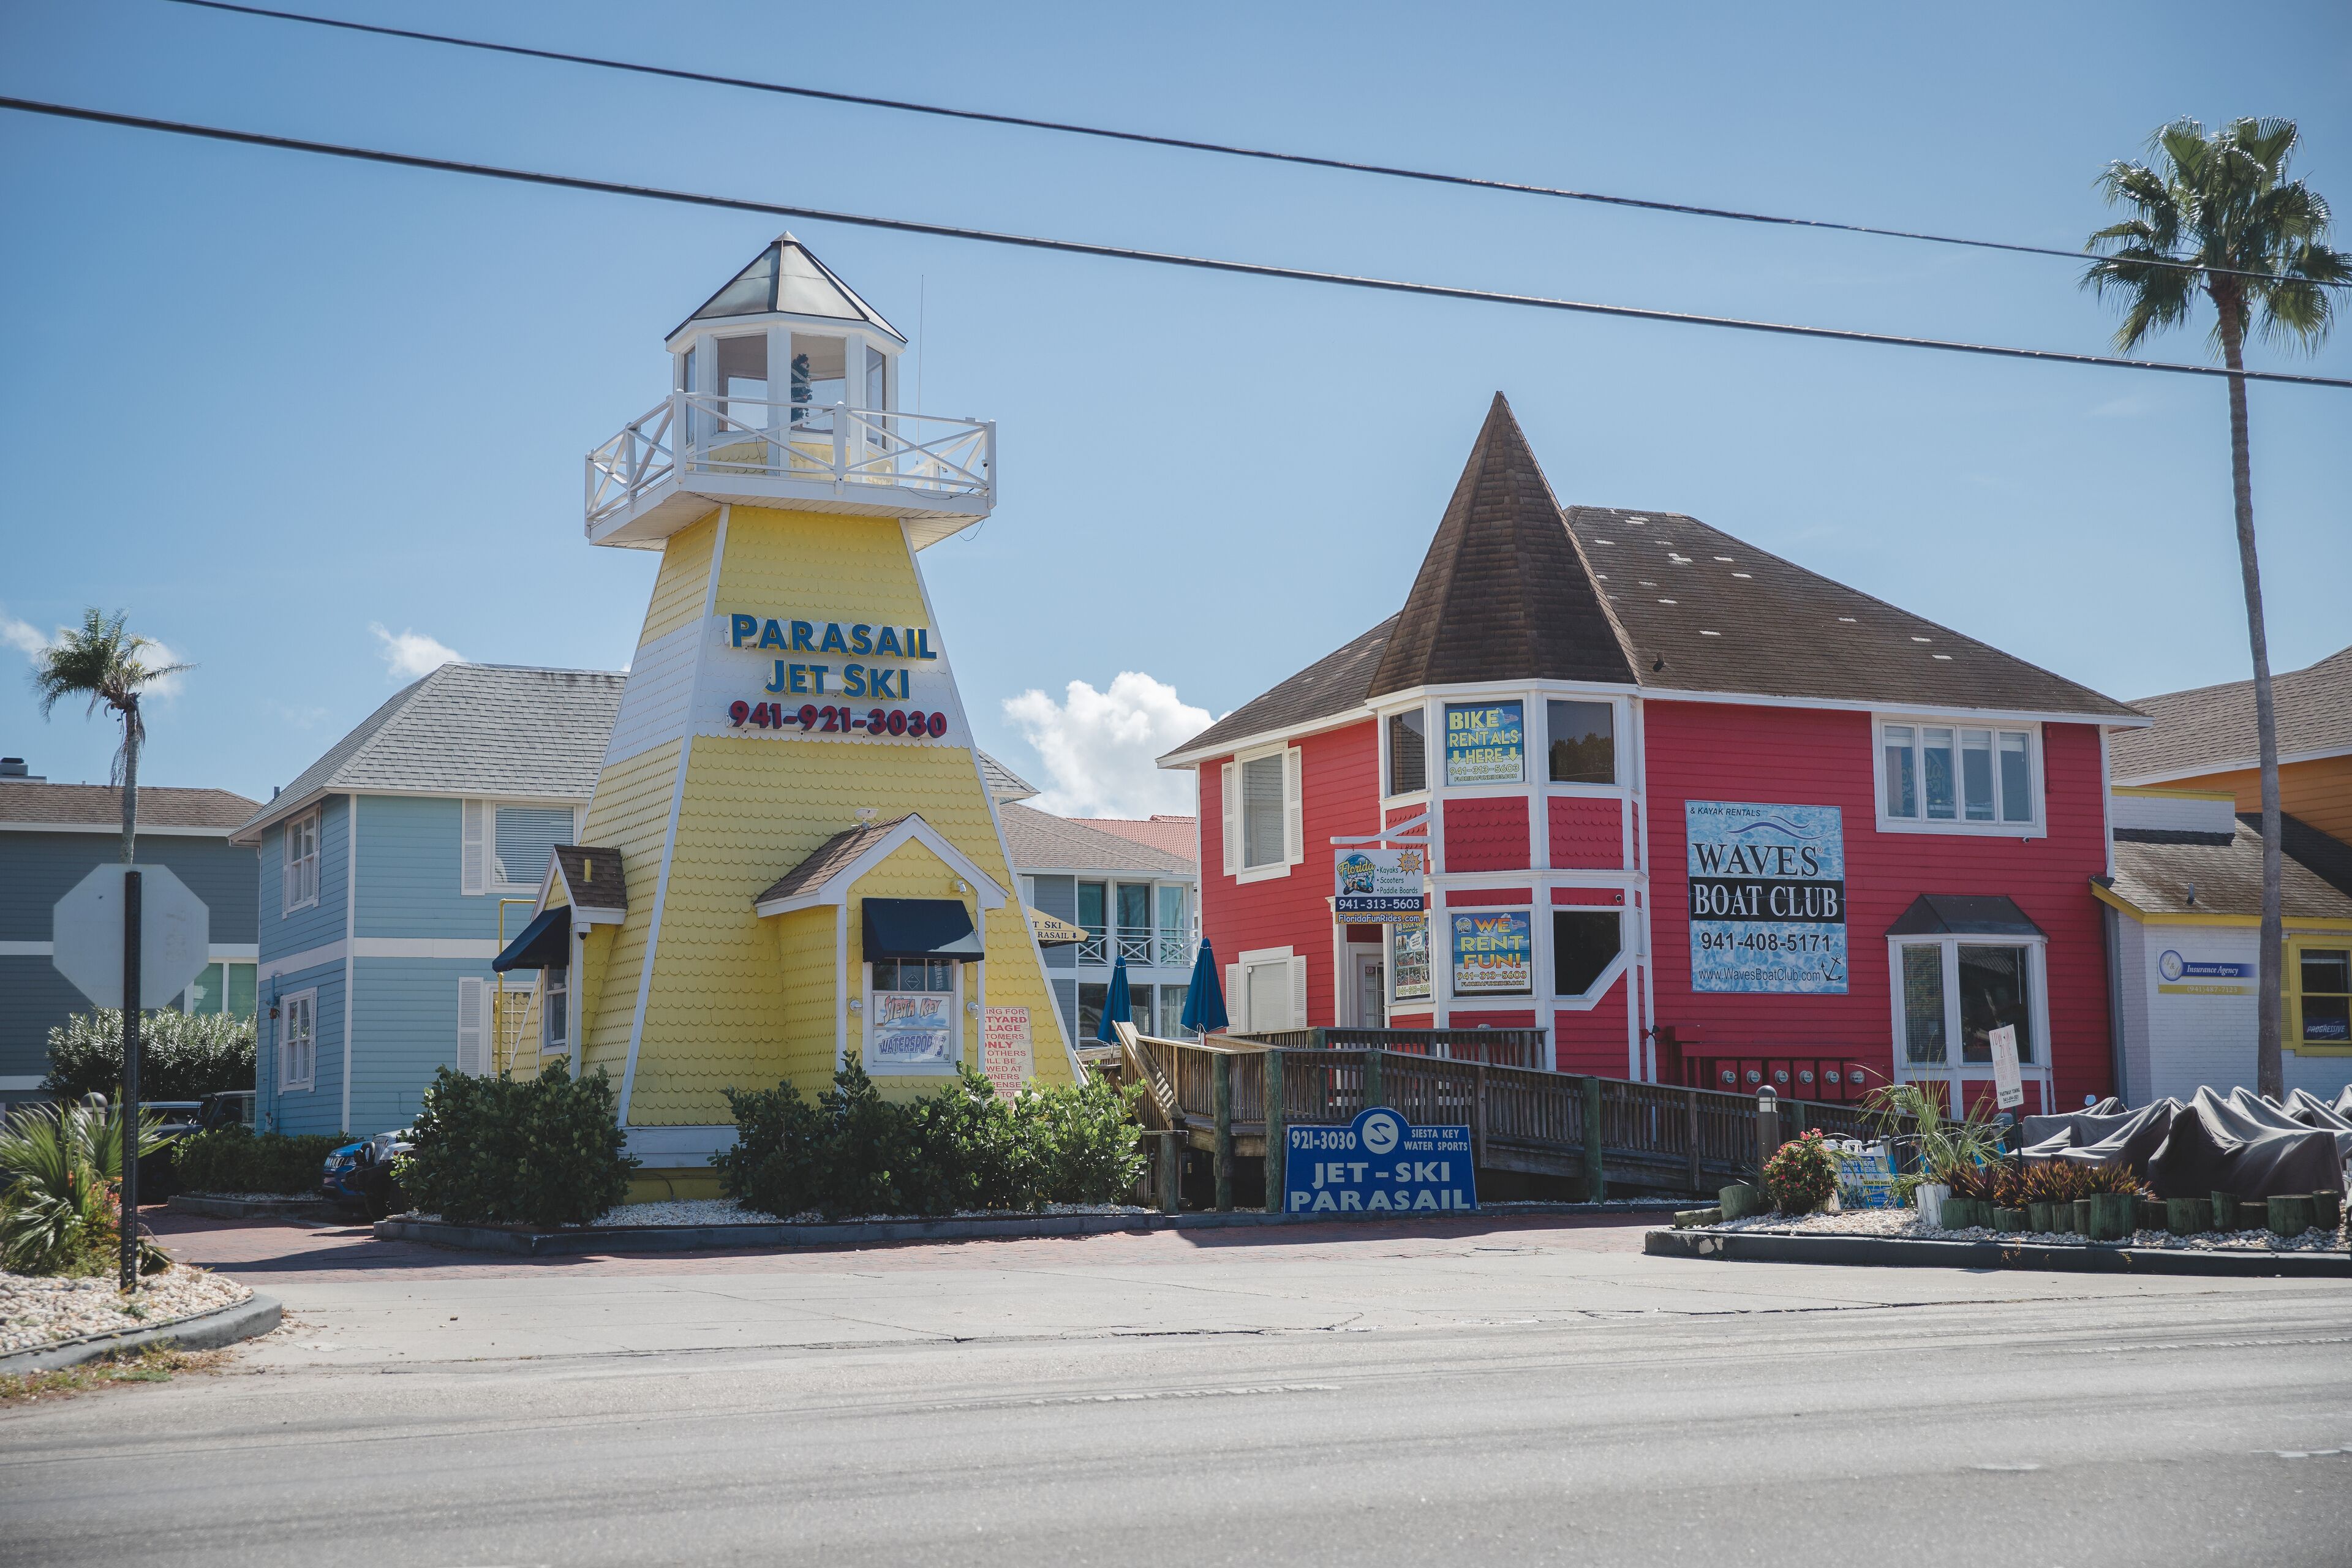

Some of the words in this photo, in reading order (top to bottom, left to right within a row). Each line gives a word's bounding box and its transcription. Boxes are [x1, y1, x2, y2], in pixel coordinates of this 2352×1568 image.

[729, 613, 937, 662] PARASAIL
[763, 660, 829, 696] JET
[841, 663, 910, 701] SKI
[729, 700, 947, 738] 941-921-3030
[1449, 709, 1499, 730] BIKE
[1449, 729, 1519, 747] RENTALS
[1466, 748, 1503, 764] HERE
[1450, 764, 1520, 775] 941-313-5603
[1337, 859, 1376, 878] Florida
[1380, 866, 1398, 875] Kayaks
[1339, 899, 1420, 910] 941-313-5603
[1693, 884, 1762, 916] BOAT
[1770, 886, 1838, 918] CLUB
[1338, 913, 1420, 923] FloridaFunRides.com
[1473, 918, 1511, 933] WE
[1460, 935, 1524, 952] RENT
[1702, 932, 1830, 952] 941-408-5171
[1463, 953, 1521, 969] FUN!
[1457, 971, 1527, 980] 941-313-5603
[1698, 968, 1820, 982] www.WavesBoatClub.com
[2187, 965, 2216, 973] Insurance
[2217, 966, 2239, 976] Agency
[884, 995, 915, 1025] SIESTA
[919, 998, 943, 1018] KEY
[2307, 1025, 2346, 1033] PROGRESSIVE
[878, 1033, 946, 1057] WATERSPORTS
[1292, 1131, 1356, 1150] 921-3030
[1411, 1129, 1438, 1138] SIESTA
[1442, 1129, 1459, 1139] KEY
[1404, 1141, 1433, 1150] WATER
[1438, 1142, 1468, 1151] SPORTS
[1291, 1189, 1470, 1212] PARASAIL
